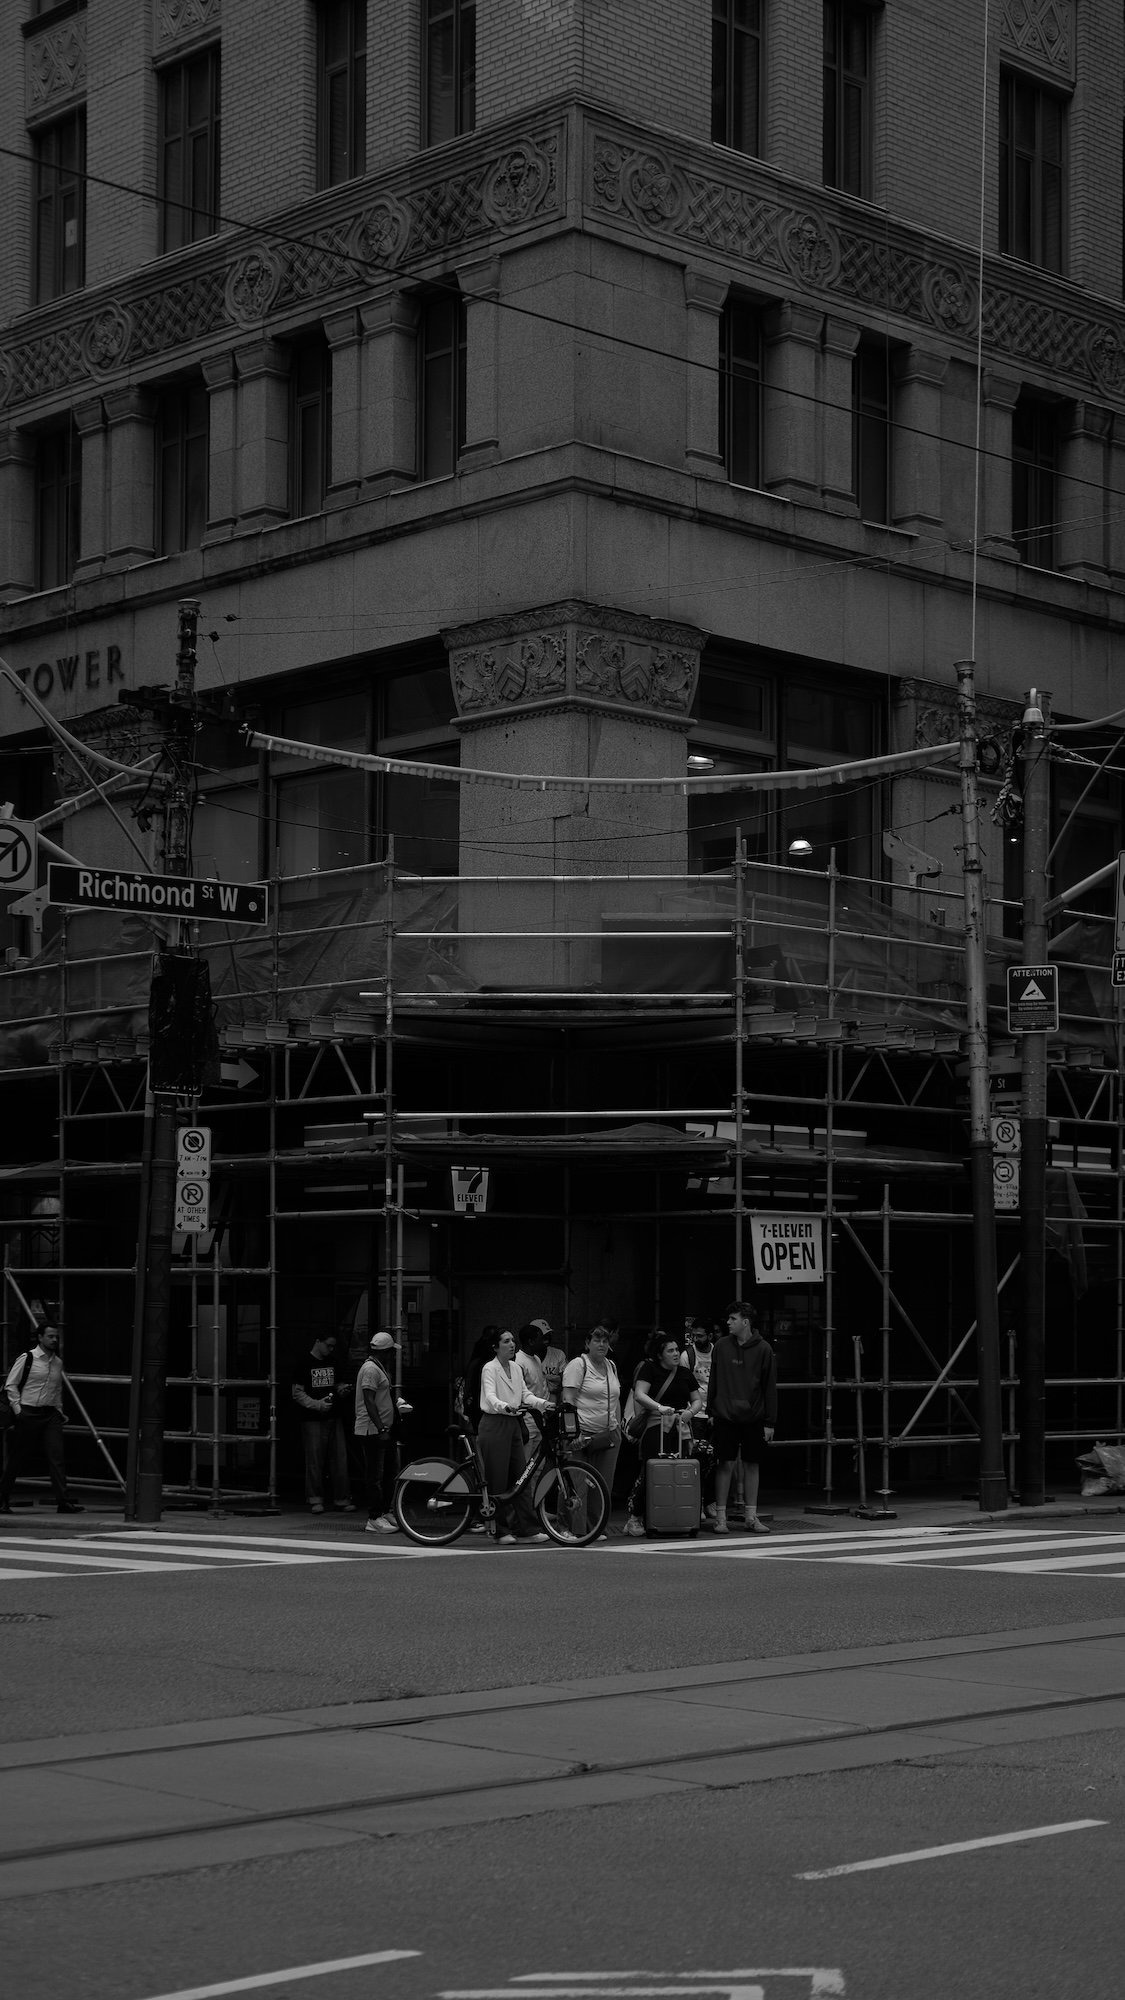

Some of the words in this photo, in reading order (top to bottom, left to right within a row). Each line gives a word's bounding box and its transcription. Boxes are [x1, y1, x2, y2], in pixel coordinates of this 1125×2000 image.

[16, 645, 125, 702] TOWER
[78, 871, 195, 908] Richmond
[201, 884, 214, 900] St
[219, 886, 239, 913] W
[187, 1206, 207, 1214] OTHER
[458, 1170, 482, 1211] 7
[760, 1242, 816, 1271] OPEN
